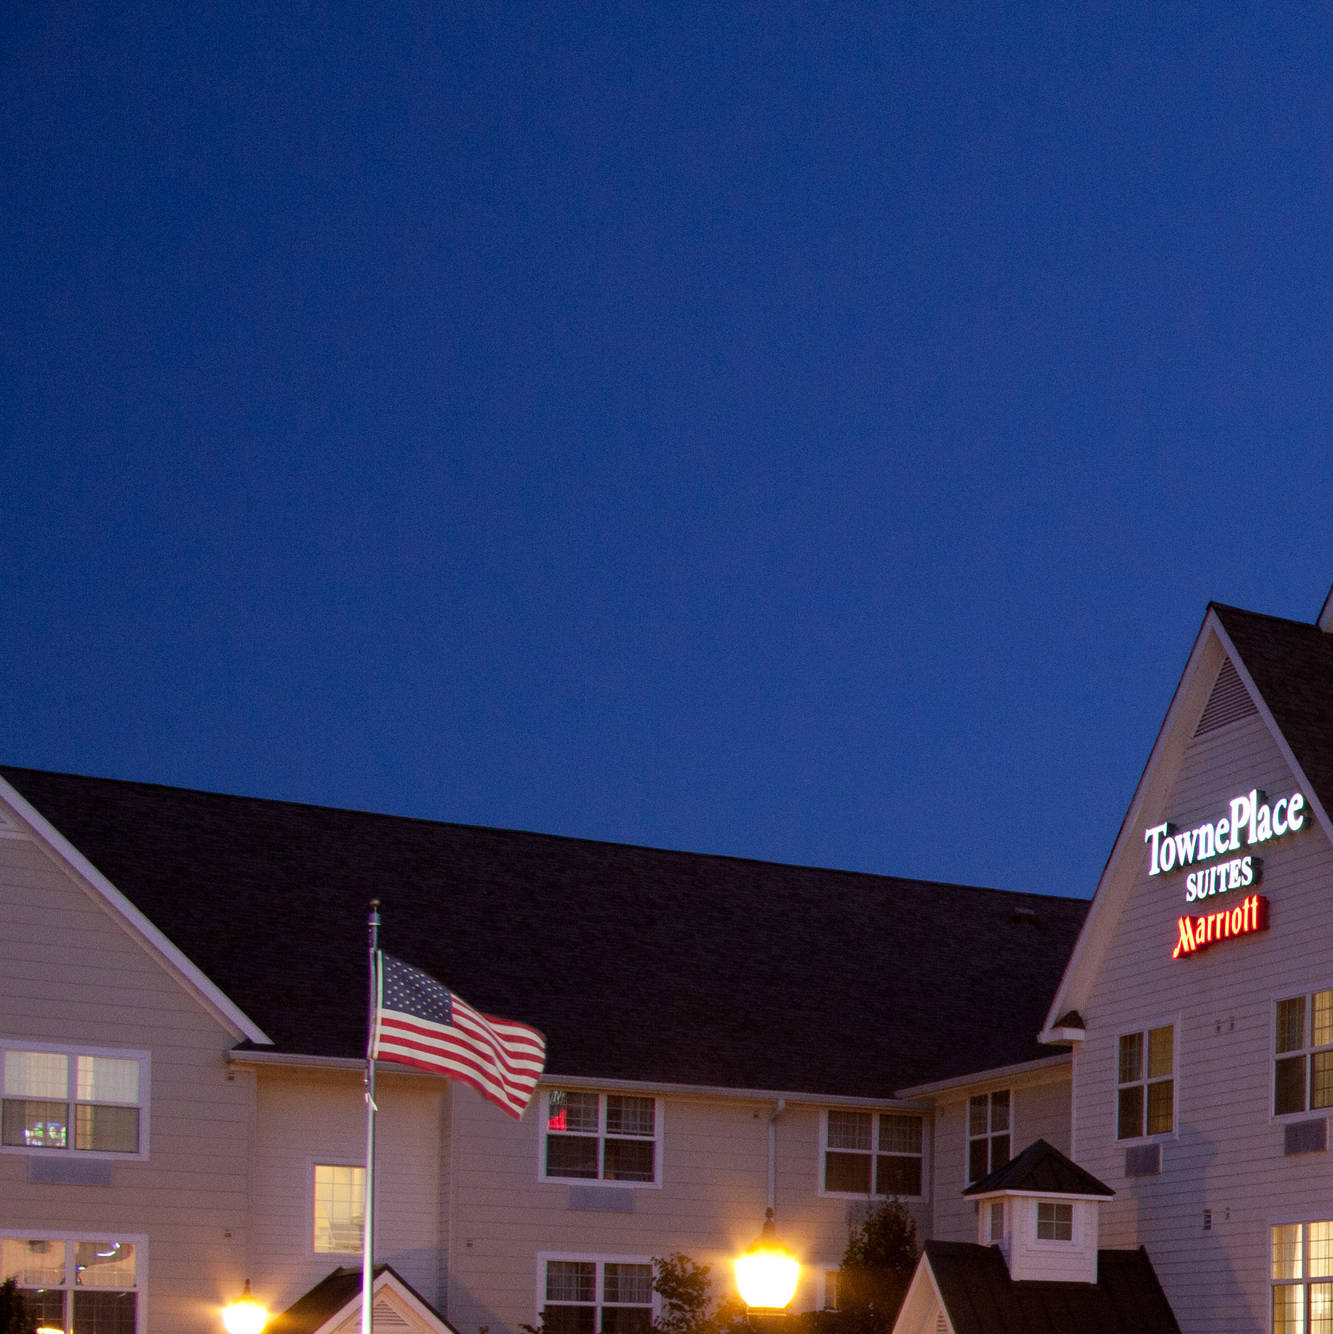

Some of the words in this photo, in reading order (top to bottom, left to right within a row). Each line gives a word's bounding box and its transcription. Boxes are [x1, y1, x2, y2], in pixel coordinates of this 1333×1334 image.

[1145, 789, 1304, 876] TownePlace
[1185, 856, 1254, 902] SUITES
[1171, 894, 1260, 959] Marriott
